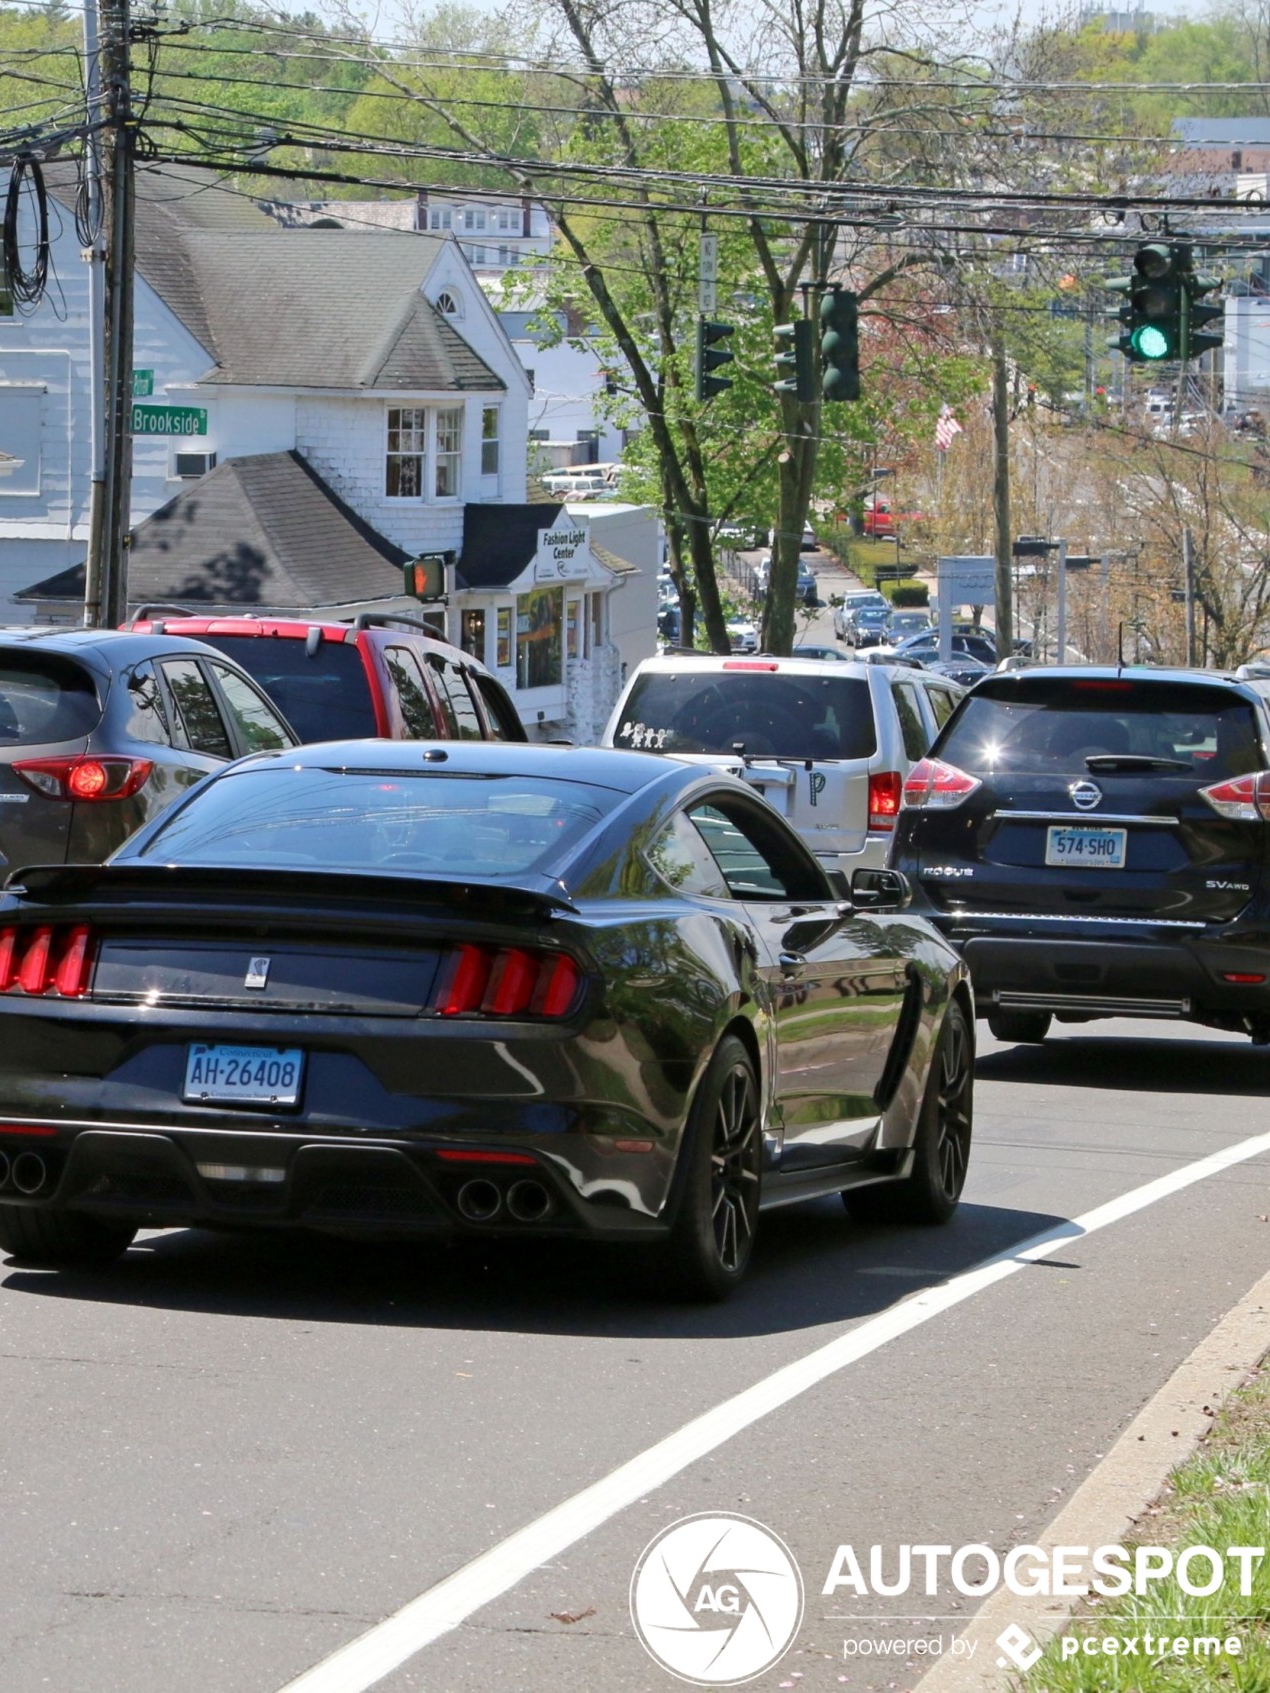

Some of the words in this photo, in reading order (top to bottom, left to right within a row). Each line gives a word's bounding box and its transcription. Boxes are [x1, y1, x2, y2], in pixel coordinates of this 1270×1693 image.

[133, 409, 199, 434] Brookside
[543, 531, 568, 546] Fashion
[569, 530, 586, 547] Light
[553, 547, 575, 559] Center
[923, 866, 974, 877] ROGUE
[219, 1047, 272, 1058] Connecticut
